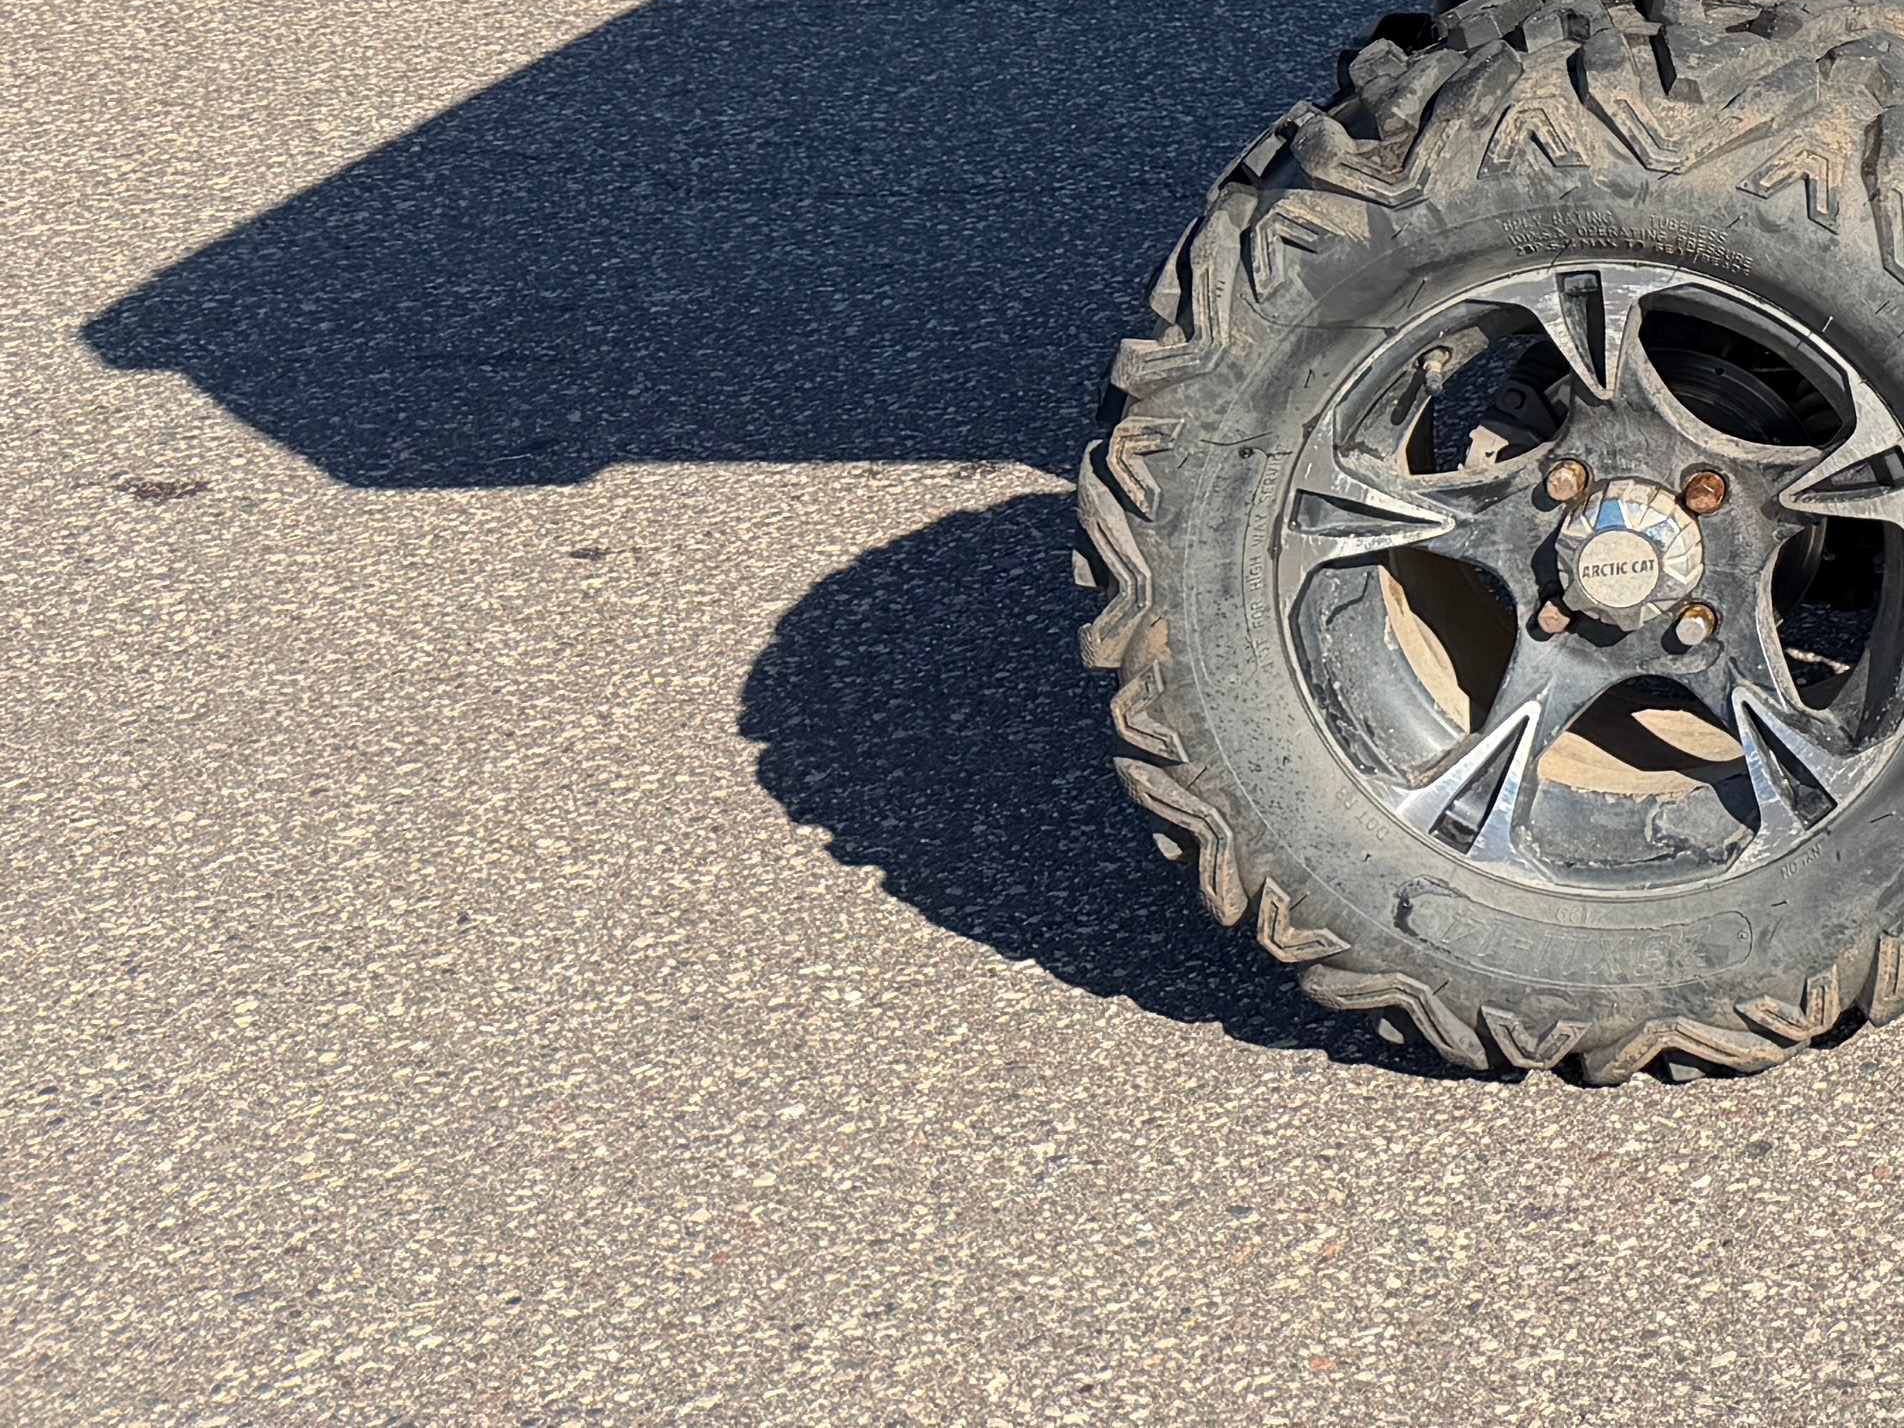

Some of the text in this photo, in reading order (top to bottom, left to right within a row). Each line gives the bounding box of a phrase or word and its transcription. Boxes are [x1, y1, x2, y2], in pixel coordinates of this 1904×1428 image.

[1553, 210, 1613, 227] RATING
[1650, 214, 1728, 243] TUBELESS
[1577, 226, 1668, 243] OPERATING
[1676, 234, 1753, 270] PRESSURE
[1251, 514, 1268, 547] WAY
[1246, 555, 1263, 591] HIGH
[1582, 559, 1655, 579] ARCTIC CAT
[1250, 599, 1266, 630] FOR
[1777, 842, 1826, 882] NYLON
